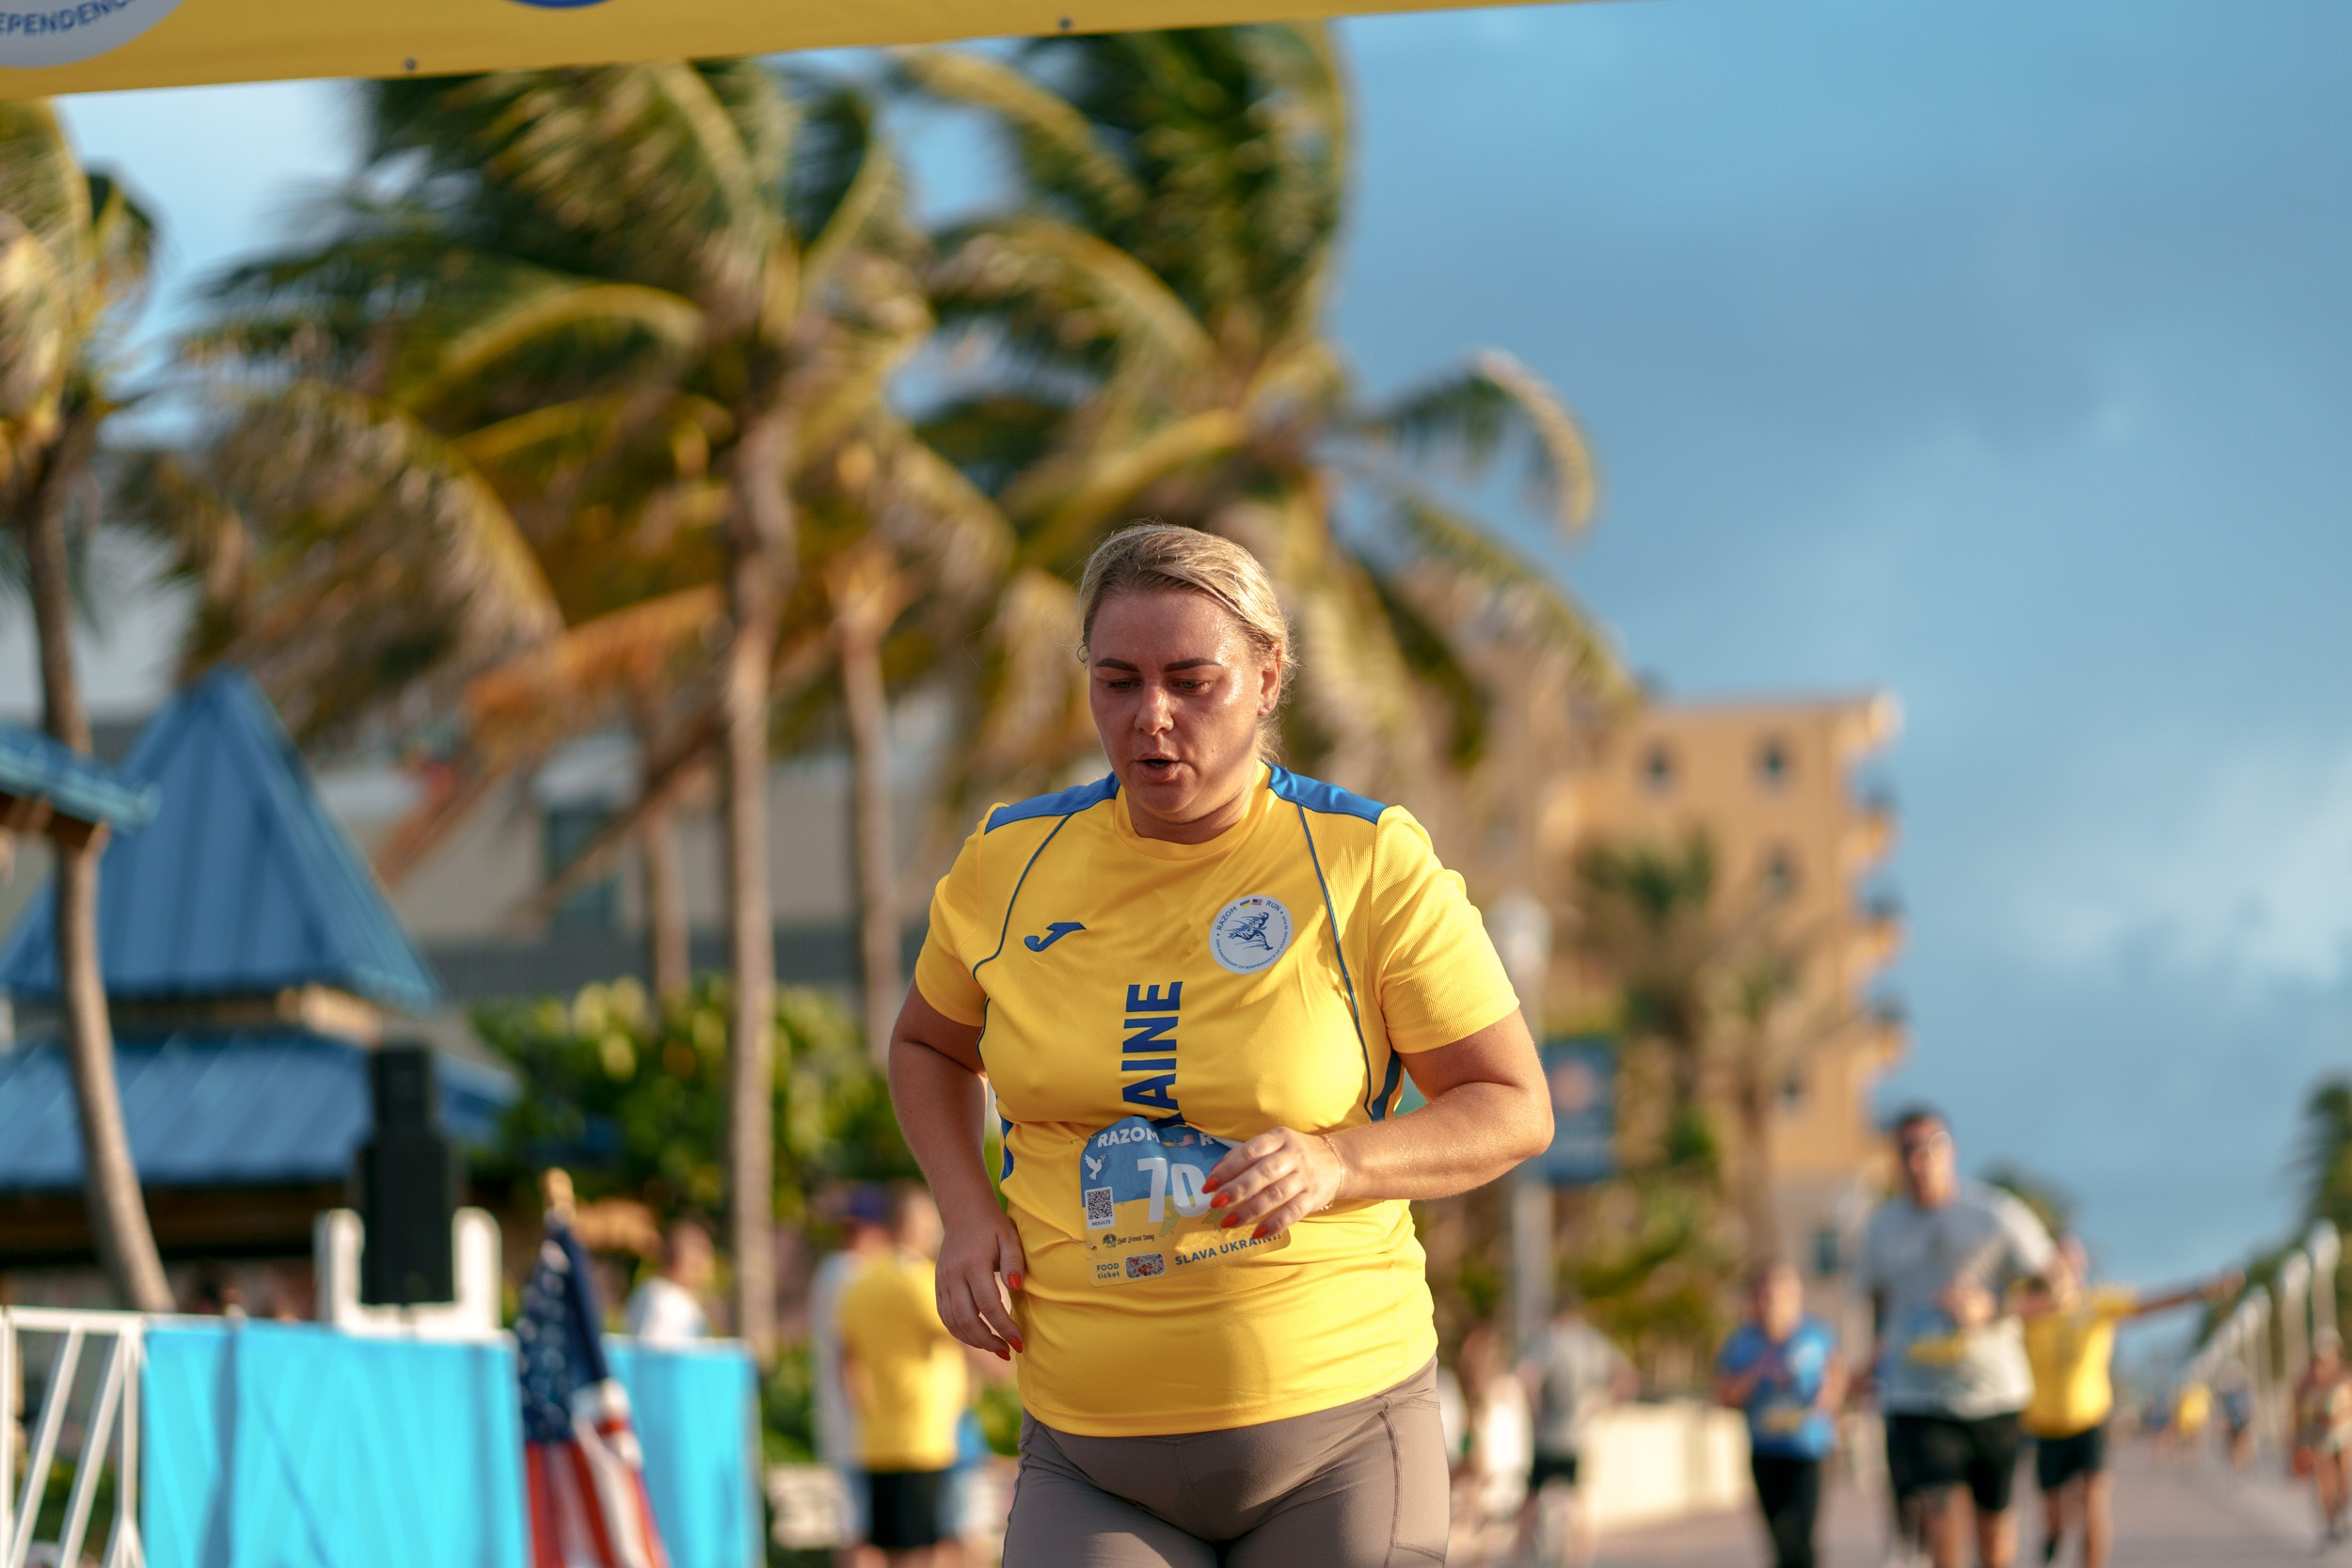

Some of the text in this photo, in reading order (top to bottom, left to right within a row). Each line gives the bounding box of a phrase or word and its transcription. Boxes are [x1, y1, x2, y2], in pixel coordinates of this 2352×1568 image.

[1216, 900, 1281, 931] RAZOM RUN
[1121, 981, 1184, 1126] AINE
[1097, 1127, 1160, 1148] RAZOM
[1174, 1247, 1217, 1265] SLAVA
[1096, 1262, 1120, 1271] FOOD
[1097, 1271, 1120, 1279] ticket
